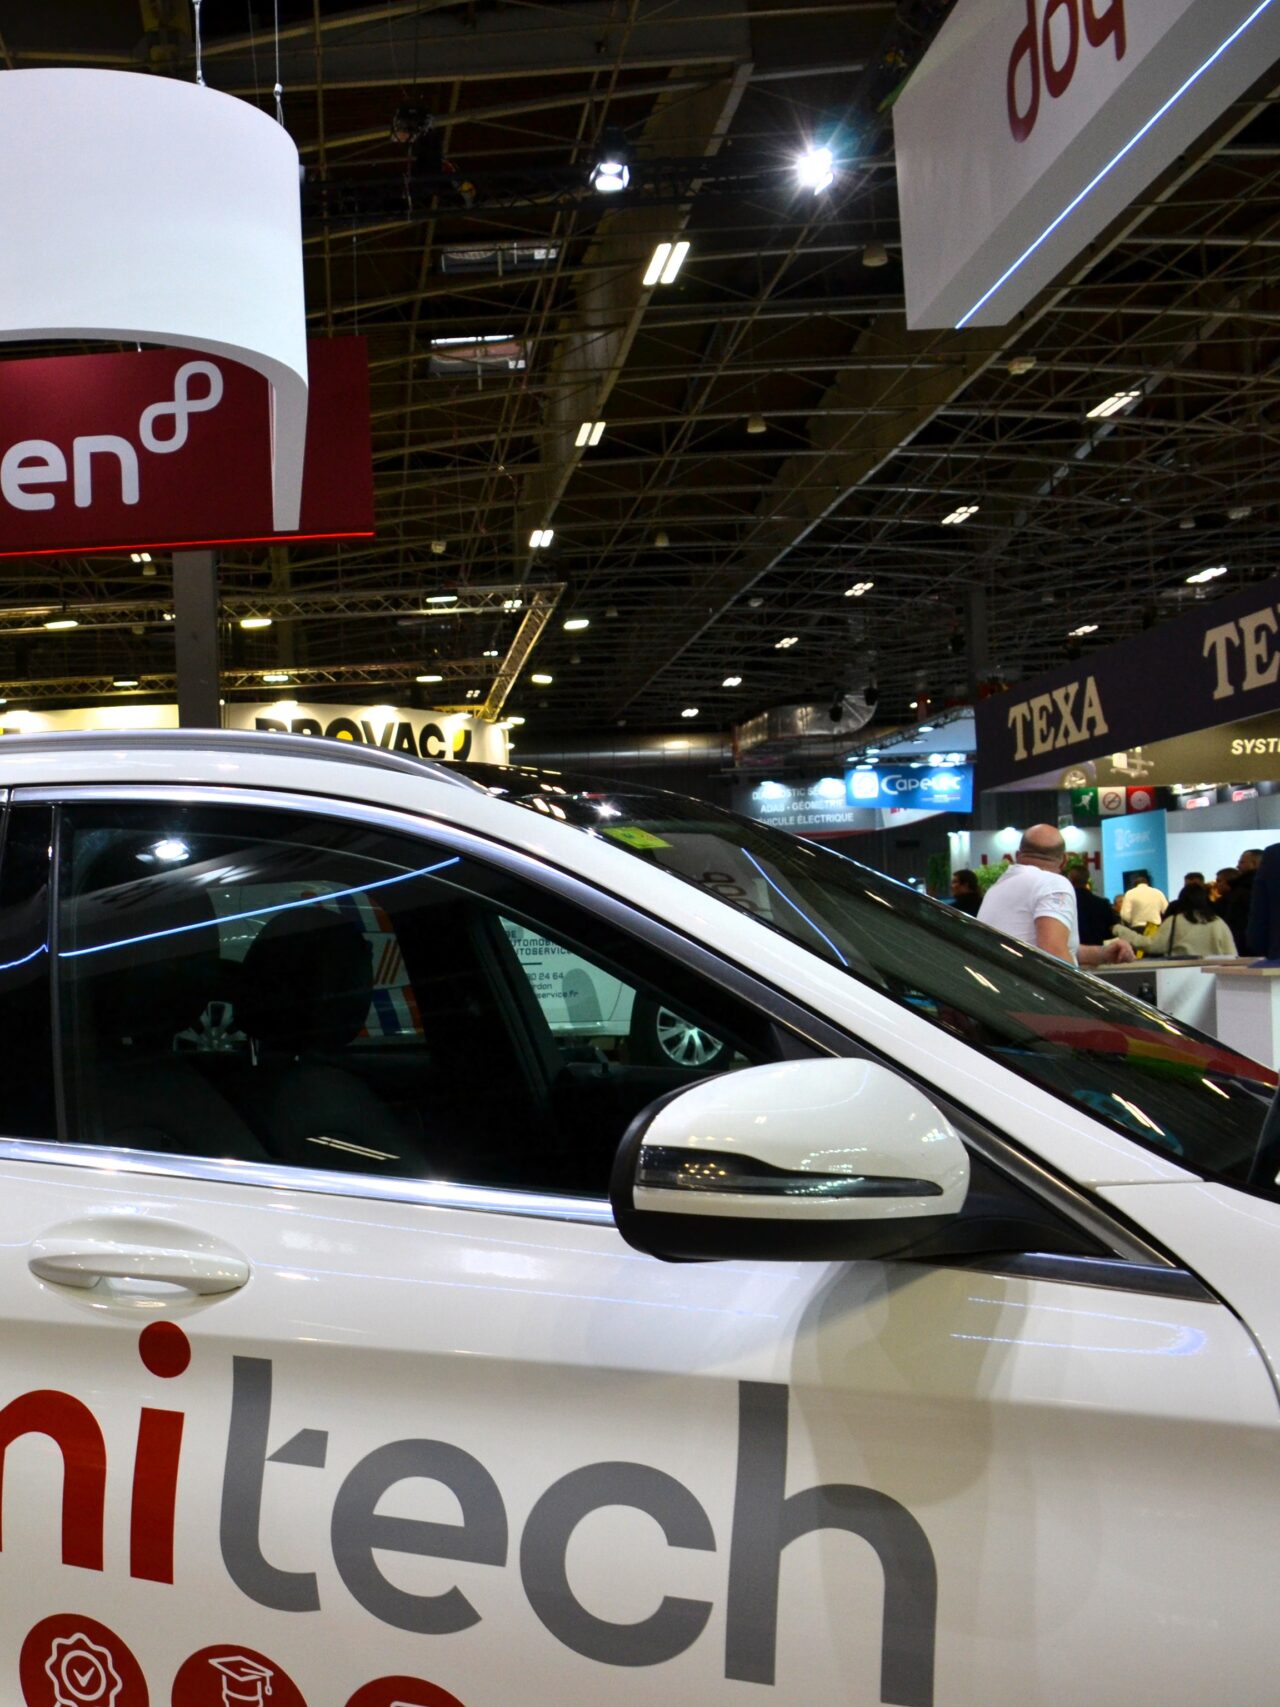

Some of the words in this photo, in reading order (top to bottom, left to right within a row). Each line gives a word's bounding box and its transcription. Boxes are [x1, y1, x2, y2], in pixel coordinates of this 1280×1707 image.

[1203, 603, 1280, 700] TE
[1008, 676, 1109, 761] TEXA
[1231, 738, 1280, 755] SYST
